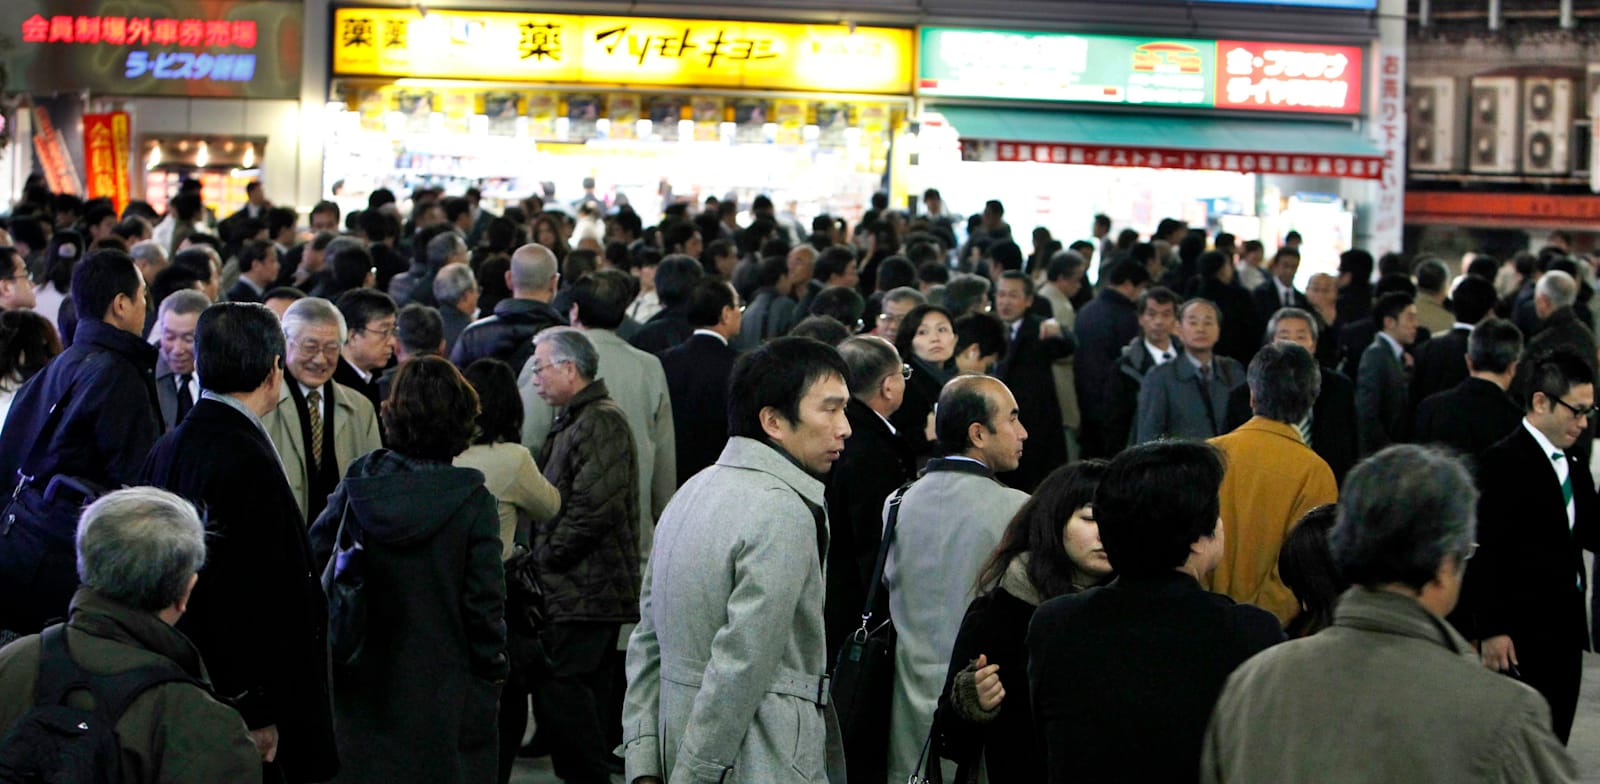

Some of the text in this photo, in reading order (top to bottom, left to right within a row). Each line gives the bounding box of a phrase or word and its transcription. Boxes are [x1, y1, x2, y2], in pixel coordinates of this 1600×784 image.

[22, 14, 257, 47] 会員制場外車券売場
[343, 18, 372, 47] 薬
[519, 22, 561, 61] 薬
[596, 26, 778, 68] マツモトキヨシ
